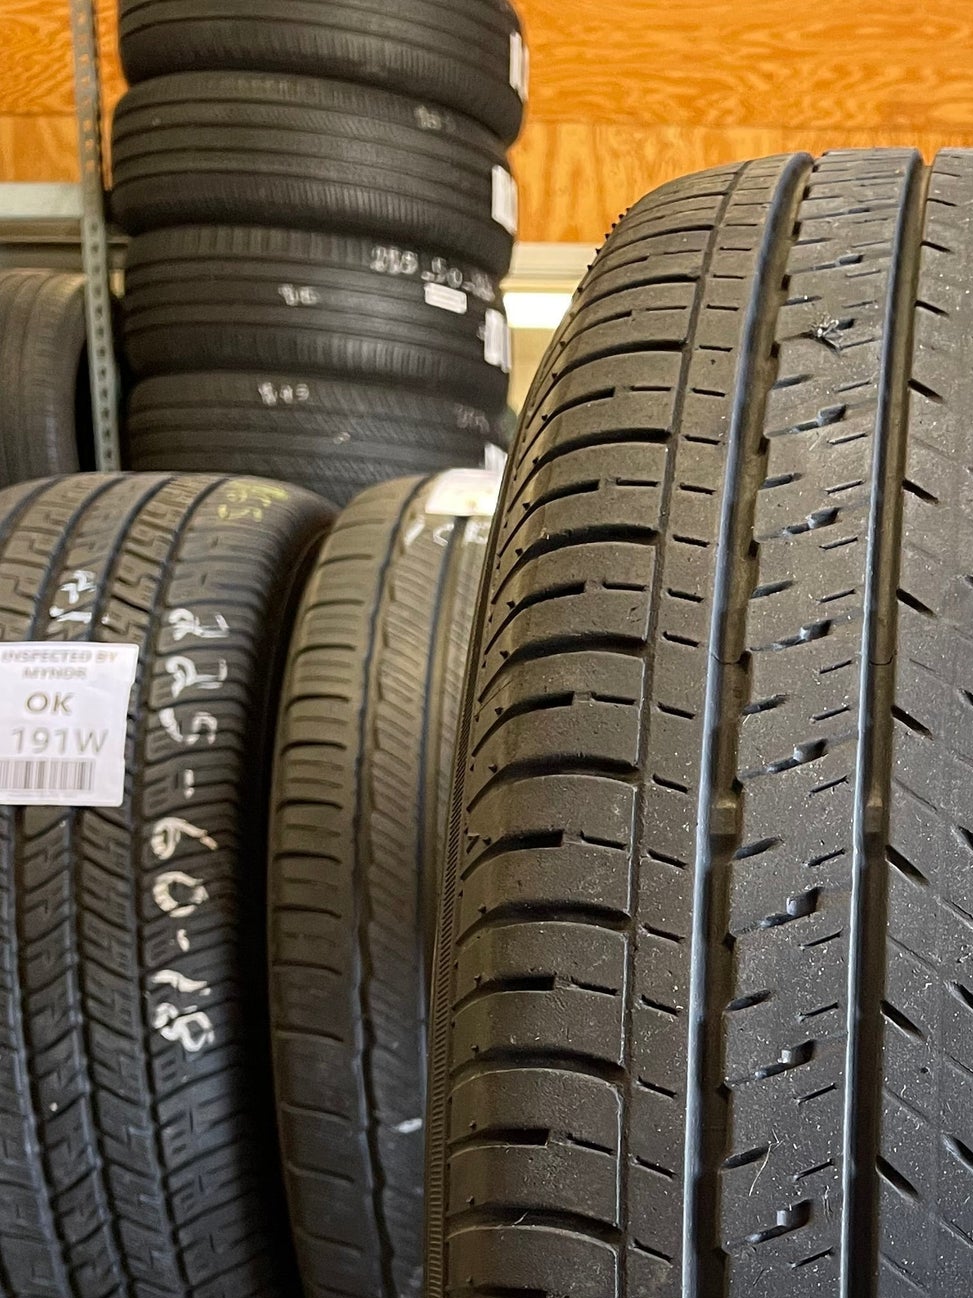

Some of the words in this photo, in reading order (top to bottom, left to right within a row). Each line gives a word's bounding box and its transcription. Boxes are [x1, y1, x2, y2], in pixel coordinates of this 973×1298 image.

[1, 650, 92, 663] INSPECTED
[95, 650, 118, 663] BY
[22, 666, 87, 679] MYNOR
[25, 691, 75, 715] OK
[12, 726, 109, 754] 191W
